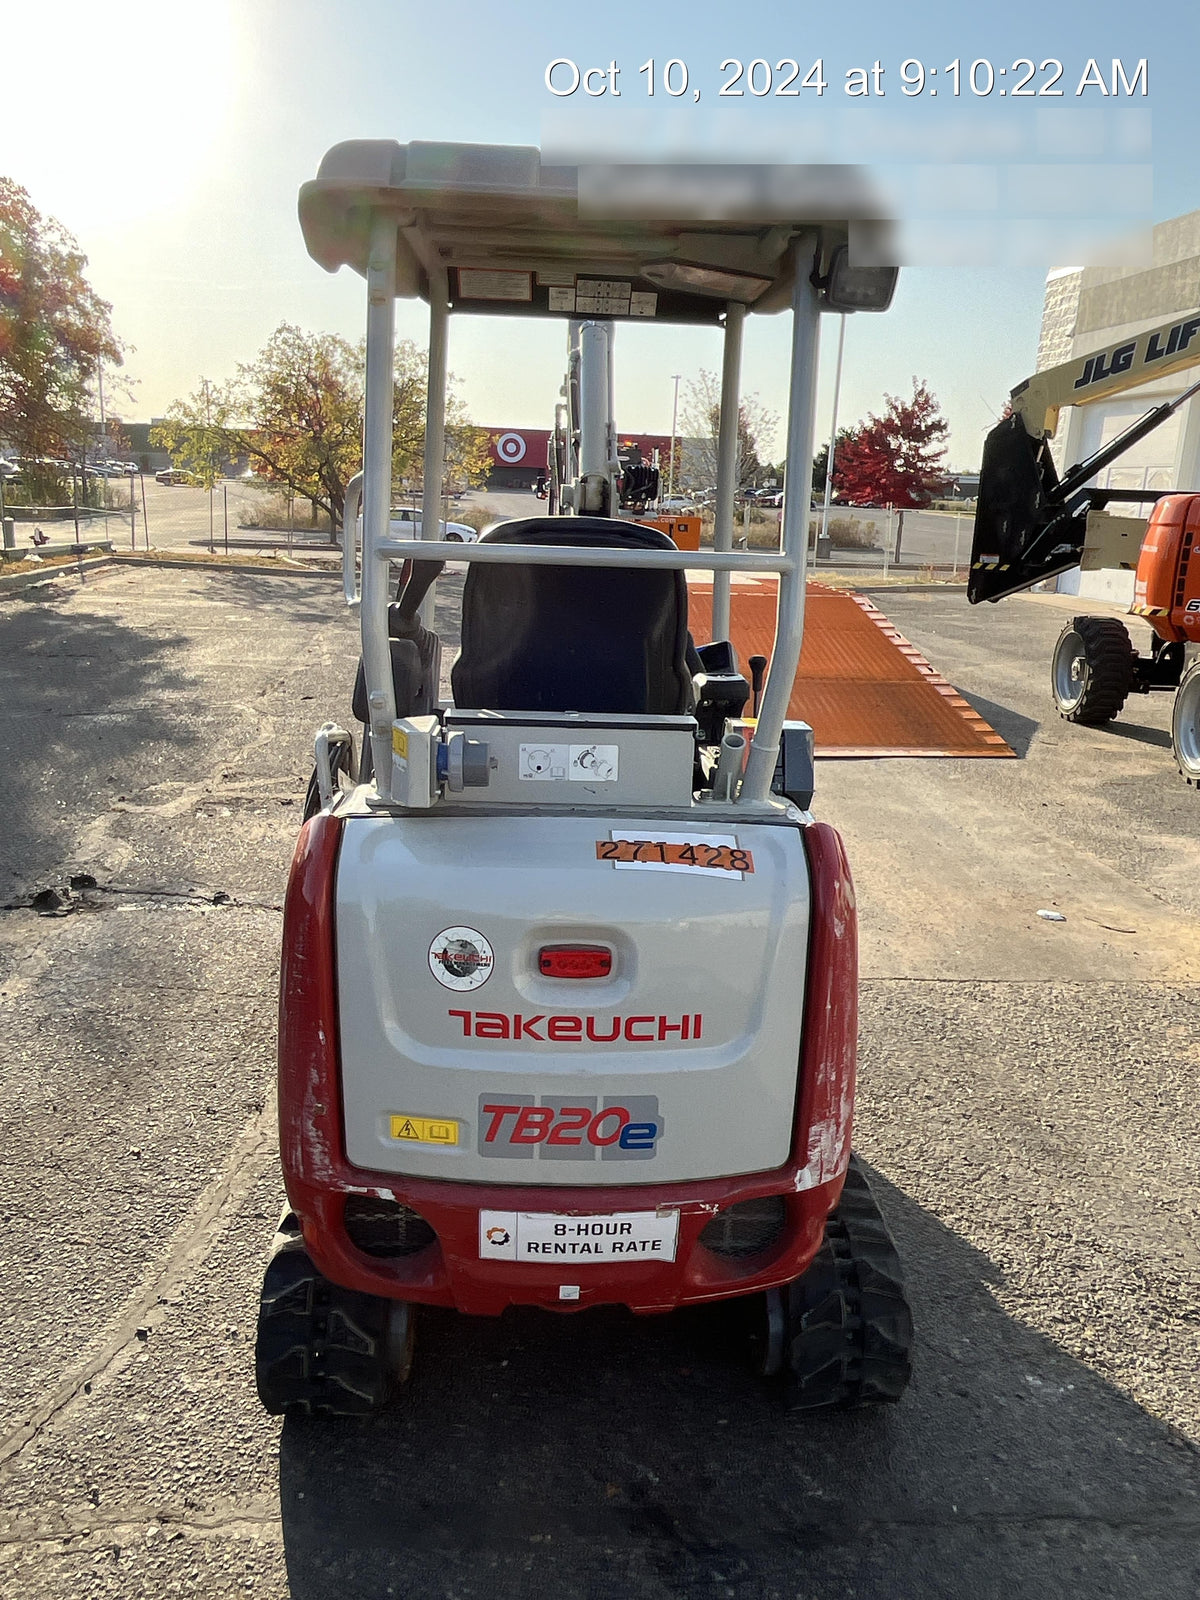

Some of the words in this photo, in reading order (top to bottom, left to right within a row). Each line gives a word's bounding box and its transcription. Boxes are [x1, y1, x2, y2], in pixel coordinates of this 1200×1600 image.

[1074, 342, 1136, 389] JLG
[601, 841, 750, 871] 271428
[448, 1009, 702, 1042] TAKEUCHI
[482, 1104, 657, 1149] TB20e
[554, 1222, 632, 1236] 8-HOUR
[527, 1242, 603, 1254] RENTAL
[611, 1240, 662, 1253] RATE
